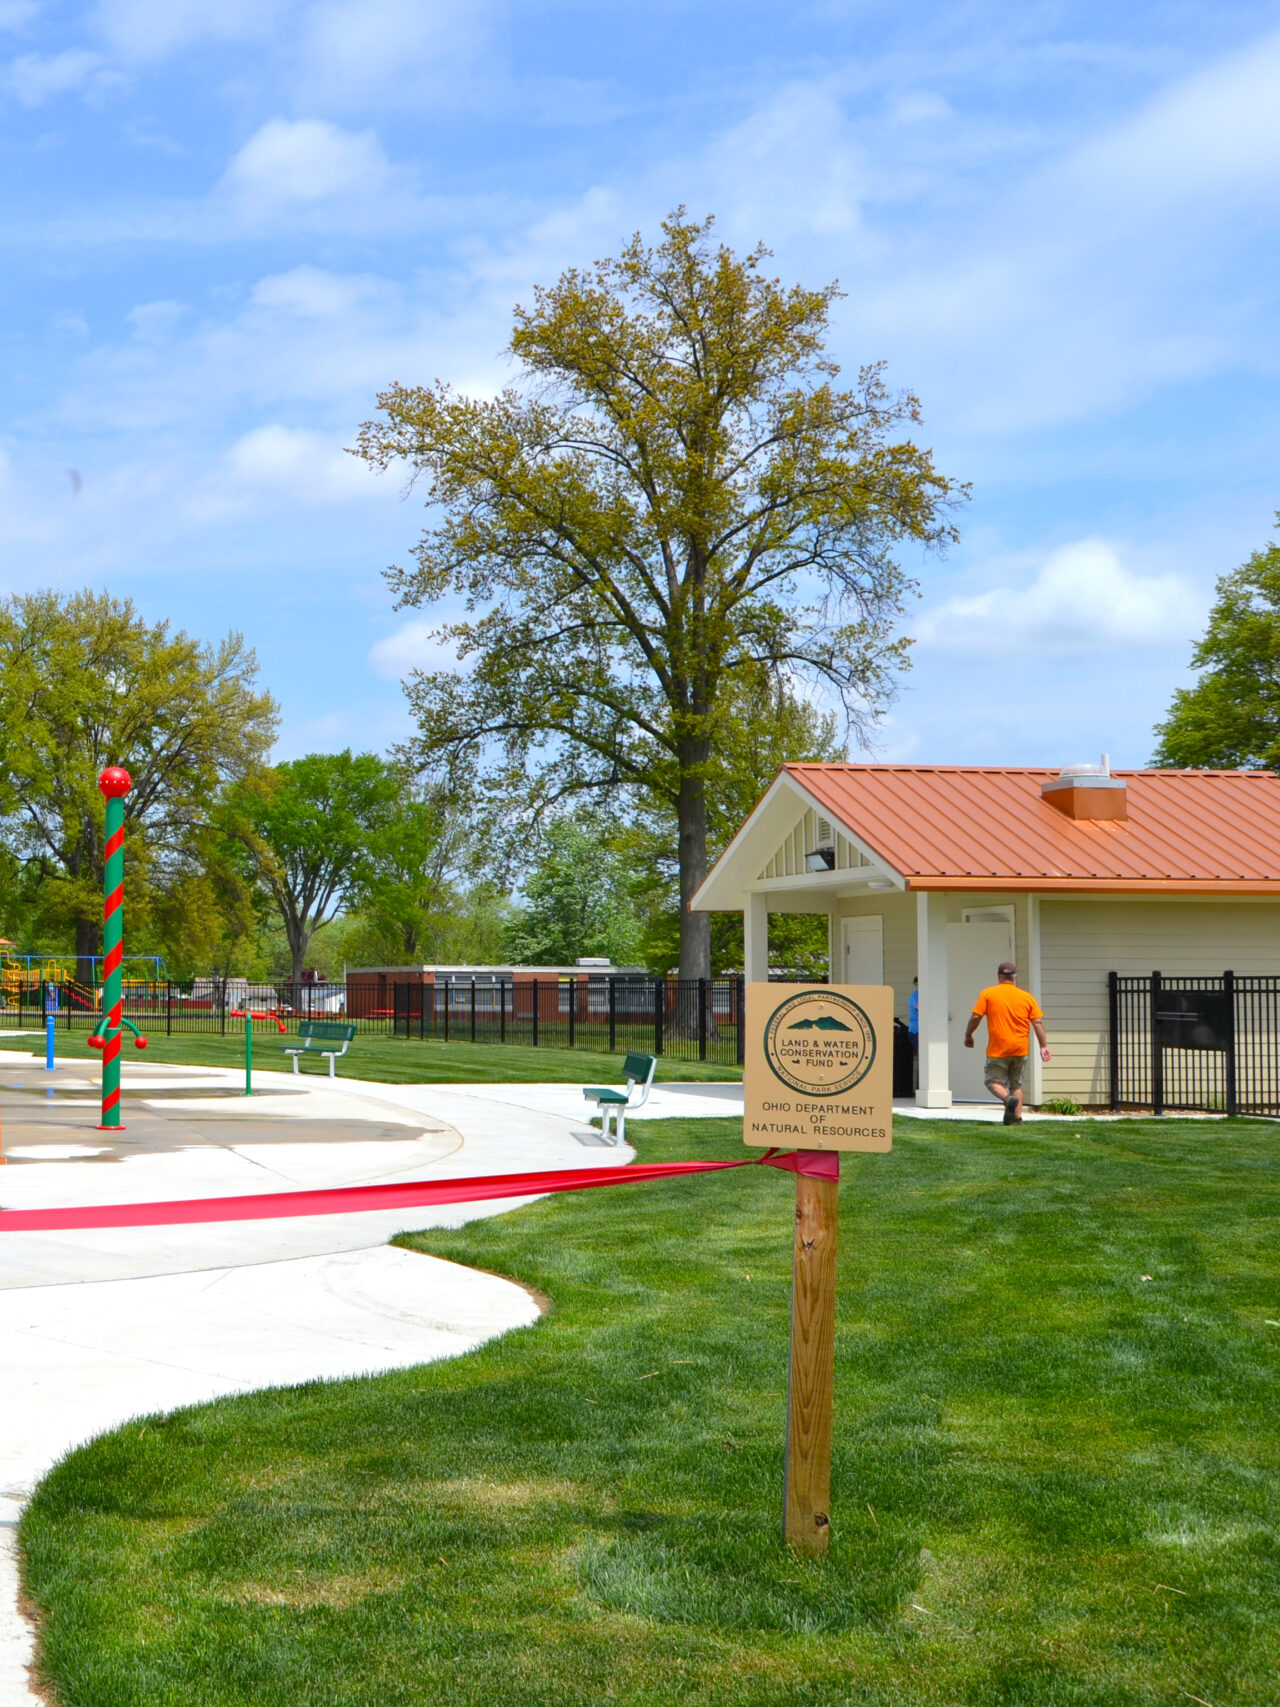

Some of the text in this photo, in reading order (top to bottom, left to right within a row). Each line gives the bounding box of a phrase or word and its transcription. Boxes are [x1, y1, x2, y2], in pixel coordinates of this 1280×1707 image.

[797, 995, 815, 1003] LOCAL
[781, 1039, 859, 1049] LAND & WATER
[780, 1048, 859, 1059] CONSERVATION
[806, 1059, 834, 1068] FUND
[777, 1065, 807, 1090] NATIONAL
[834, 1070, 863, 1090] SERVICE
[762, 1101, 875, 1115] OHIO DEPARTMENT
[809, 1114, 826, 1124] OF
[752, 1123, 886, 1138] NATURAL RESOURCES
